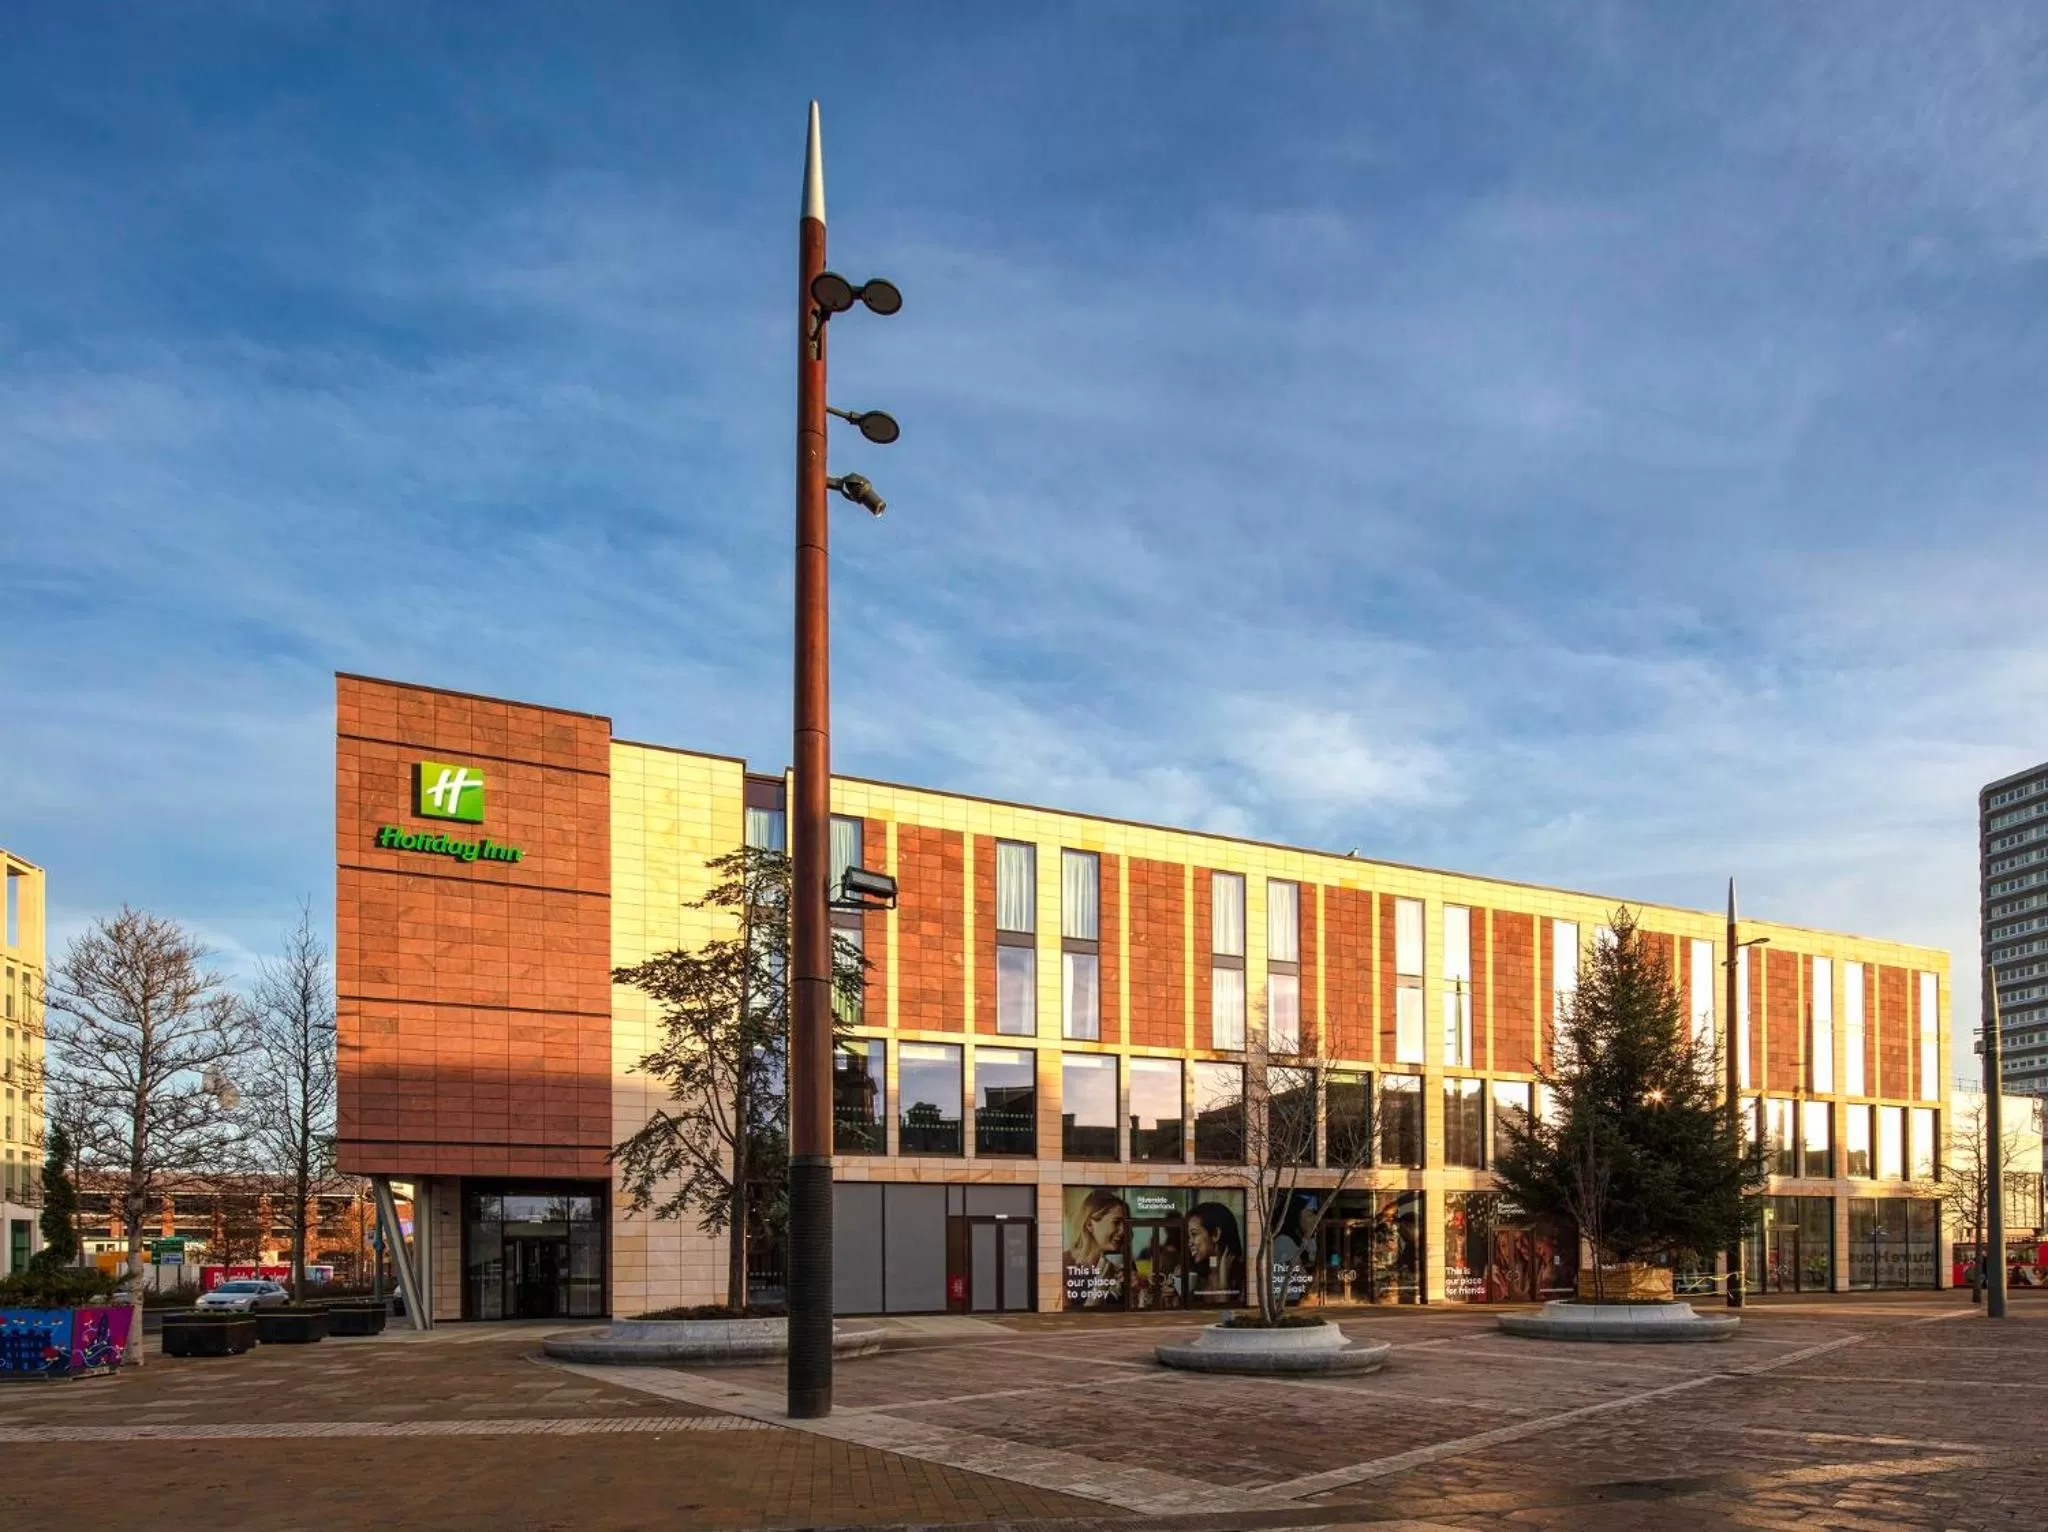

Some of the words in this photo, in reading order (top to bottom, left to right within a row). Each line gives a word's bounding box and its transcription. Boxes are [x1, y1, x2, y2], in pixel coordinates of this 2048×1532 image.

[379, 824, 480, 862] Holiday
[483, 839, 524, 863] Inn
[1067, 1265, 1090, 1276] This
[1091, 1264, 1100, 1275] is
[1445, 1266, 1463, 1275] This
[1066, 1278, 1085, 1288] our
[1087, 1277, 1116, 1288] place
[1445, 1278, 1460, 1286] our
[1460, 1276, 1483, 1286] place
[1067, 1289, 1078, 1299] to
[1080, 1287, 1109, 1300] enjoy
[1458, 1285, 1486, 1295] friends
